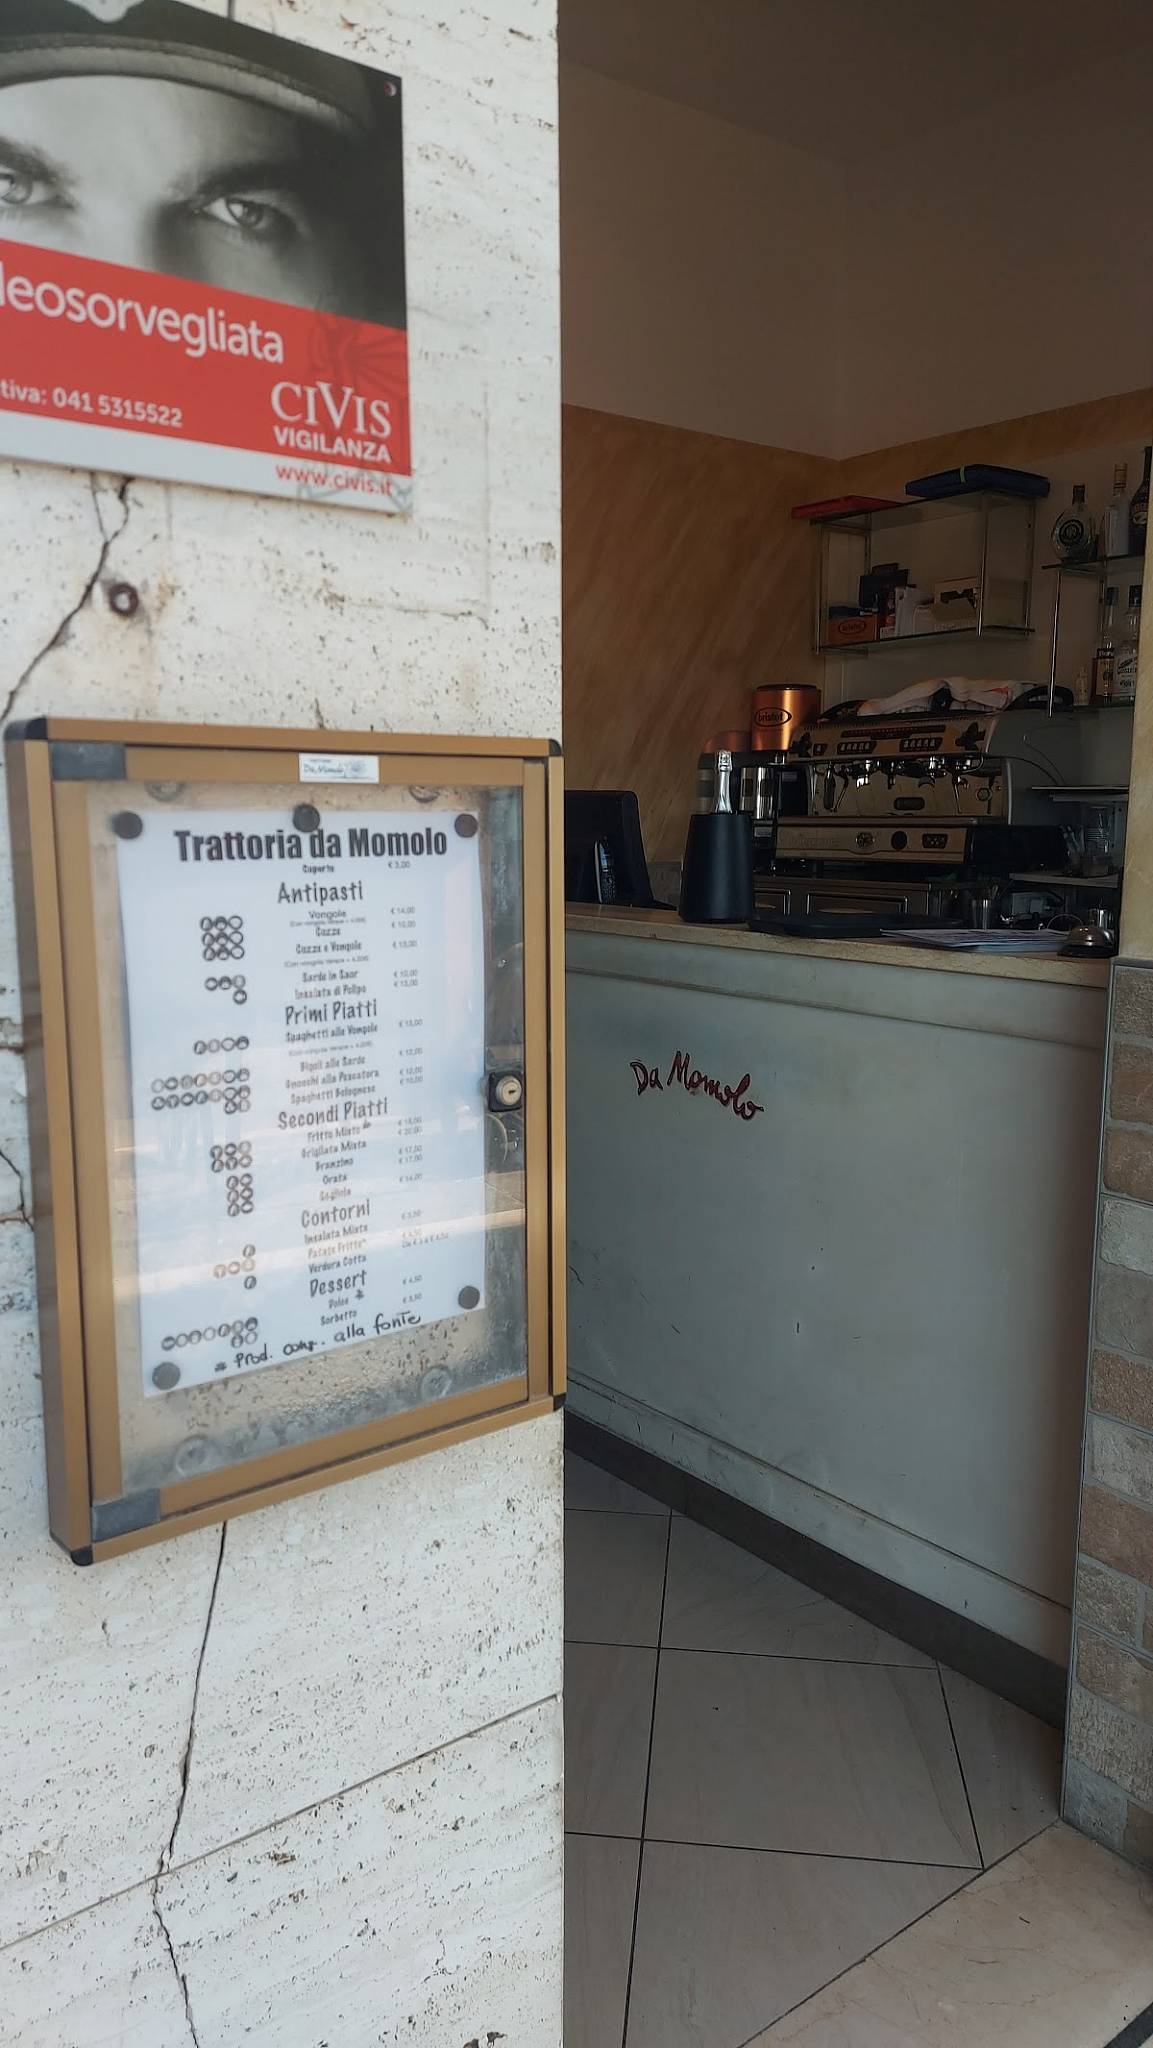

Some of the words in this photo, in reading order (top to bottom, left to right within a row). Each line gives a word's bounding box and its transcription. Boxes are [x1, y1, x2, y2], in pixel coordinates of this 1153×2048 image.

[53, 387, 92, 413] 041
[98, 395, 182, 428] 5315522
[273, 426, 392, 464] VIGILANZA
[275, 464, 393, 496] www.civis.it
[757, 709, 787, 724] bristot
[174, 829, 302, 861] Trattoria
[310, 830, 341, 859] da
[349, 828, 448, 857] Momolo
[302, 865, 335, 874] Coperto
[277, 881, 363, 906] Antipasti
[308, 910, 346, 920] Vongole
[316, 926, 341, 937] Cozze
[296, 944, 321, 954] Cozze
[330, 940, 362, 952] Vongole
[302, 971, 327, 983] Sarde
[328, 970, 337, 980] in
[339, 969, 358, 979] Saor
[295, 988, 330, 1000] Insalata
[334, 986, 340, 996] di
[285, 1003, 327, 1026] Primi
[333, 999, 377, 1021] Piatti
[286, 1029, 328, 1043] Spaghetti
[331, 1027, 345, 1037] alle
[347, 1022, 378, 1036] Vongole
[300, 1061, 323, 1072] Bigoli
[325, 1058, 339, 1068] alle
[342, 1056, 365, 1067] Sarde
[285, 1076, 319, 1089] Gnocchi
[321, 1074, 336, 1084] alla
[339, 1069, 379, 1083] Pescatora
[630, 1062, 663, 1096] Da
[667, 1051, 764, 1120] Momolo
[291, 1089, 333, 1106] Spaghetti
[335, 1084, 375, 1098] Bolognese
[278, 1104, 338, 1130] Secondi
[344, 1096, 388, 1120] Piatti
[307, 1130, 333, 1143] Fritto
[335, 1126, 360, 1138] Misto
[301, 1145, 337, 1159] Grigliata
[341, 1140, 366, 1152] Mista
[316, 1157, 354, 1172] Branzino
[322, 1173, 347, 1185] Orata
[301, 1198, 370, 1228] Contorni
[304, 1228, 340, 1244] Insalata
[343, 1223, 368, 1236] Mista
[308, 1245, 336, 1259] Patate
[308, 1260, 341, 1274] Verdura
[343, 1255, 367, 1267] Cotta
[310, 1270, 367, 1298] Dessert
[328, 1296, 349, 1309] Dolce
[320, 1310, 357, 1327] Sorbetto
[333, 1323, 365, 1343] alla
